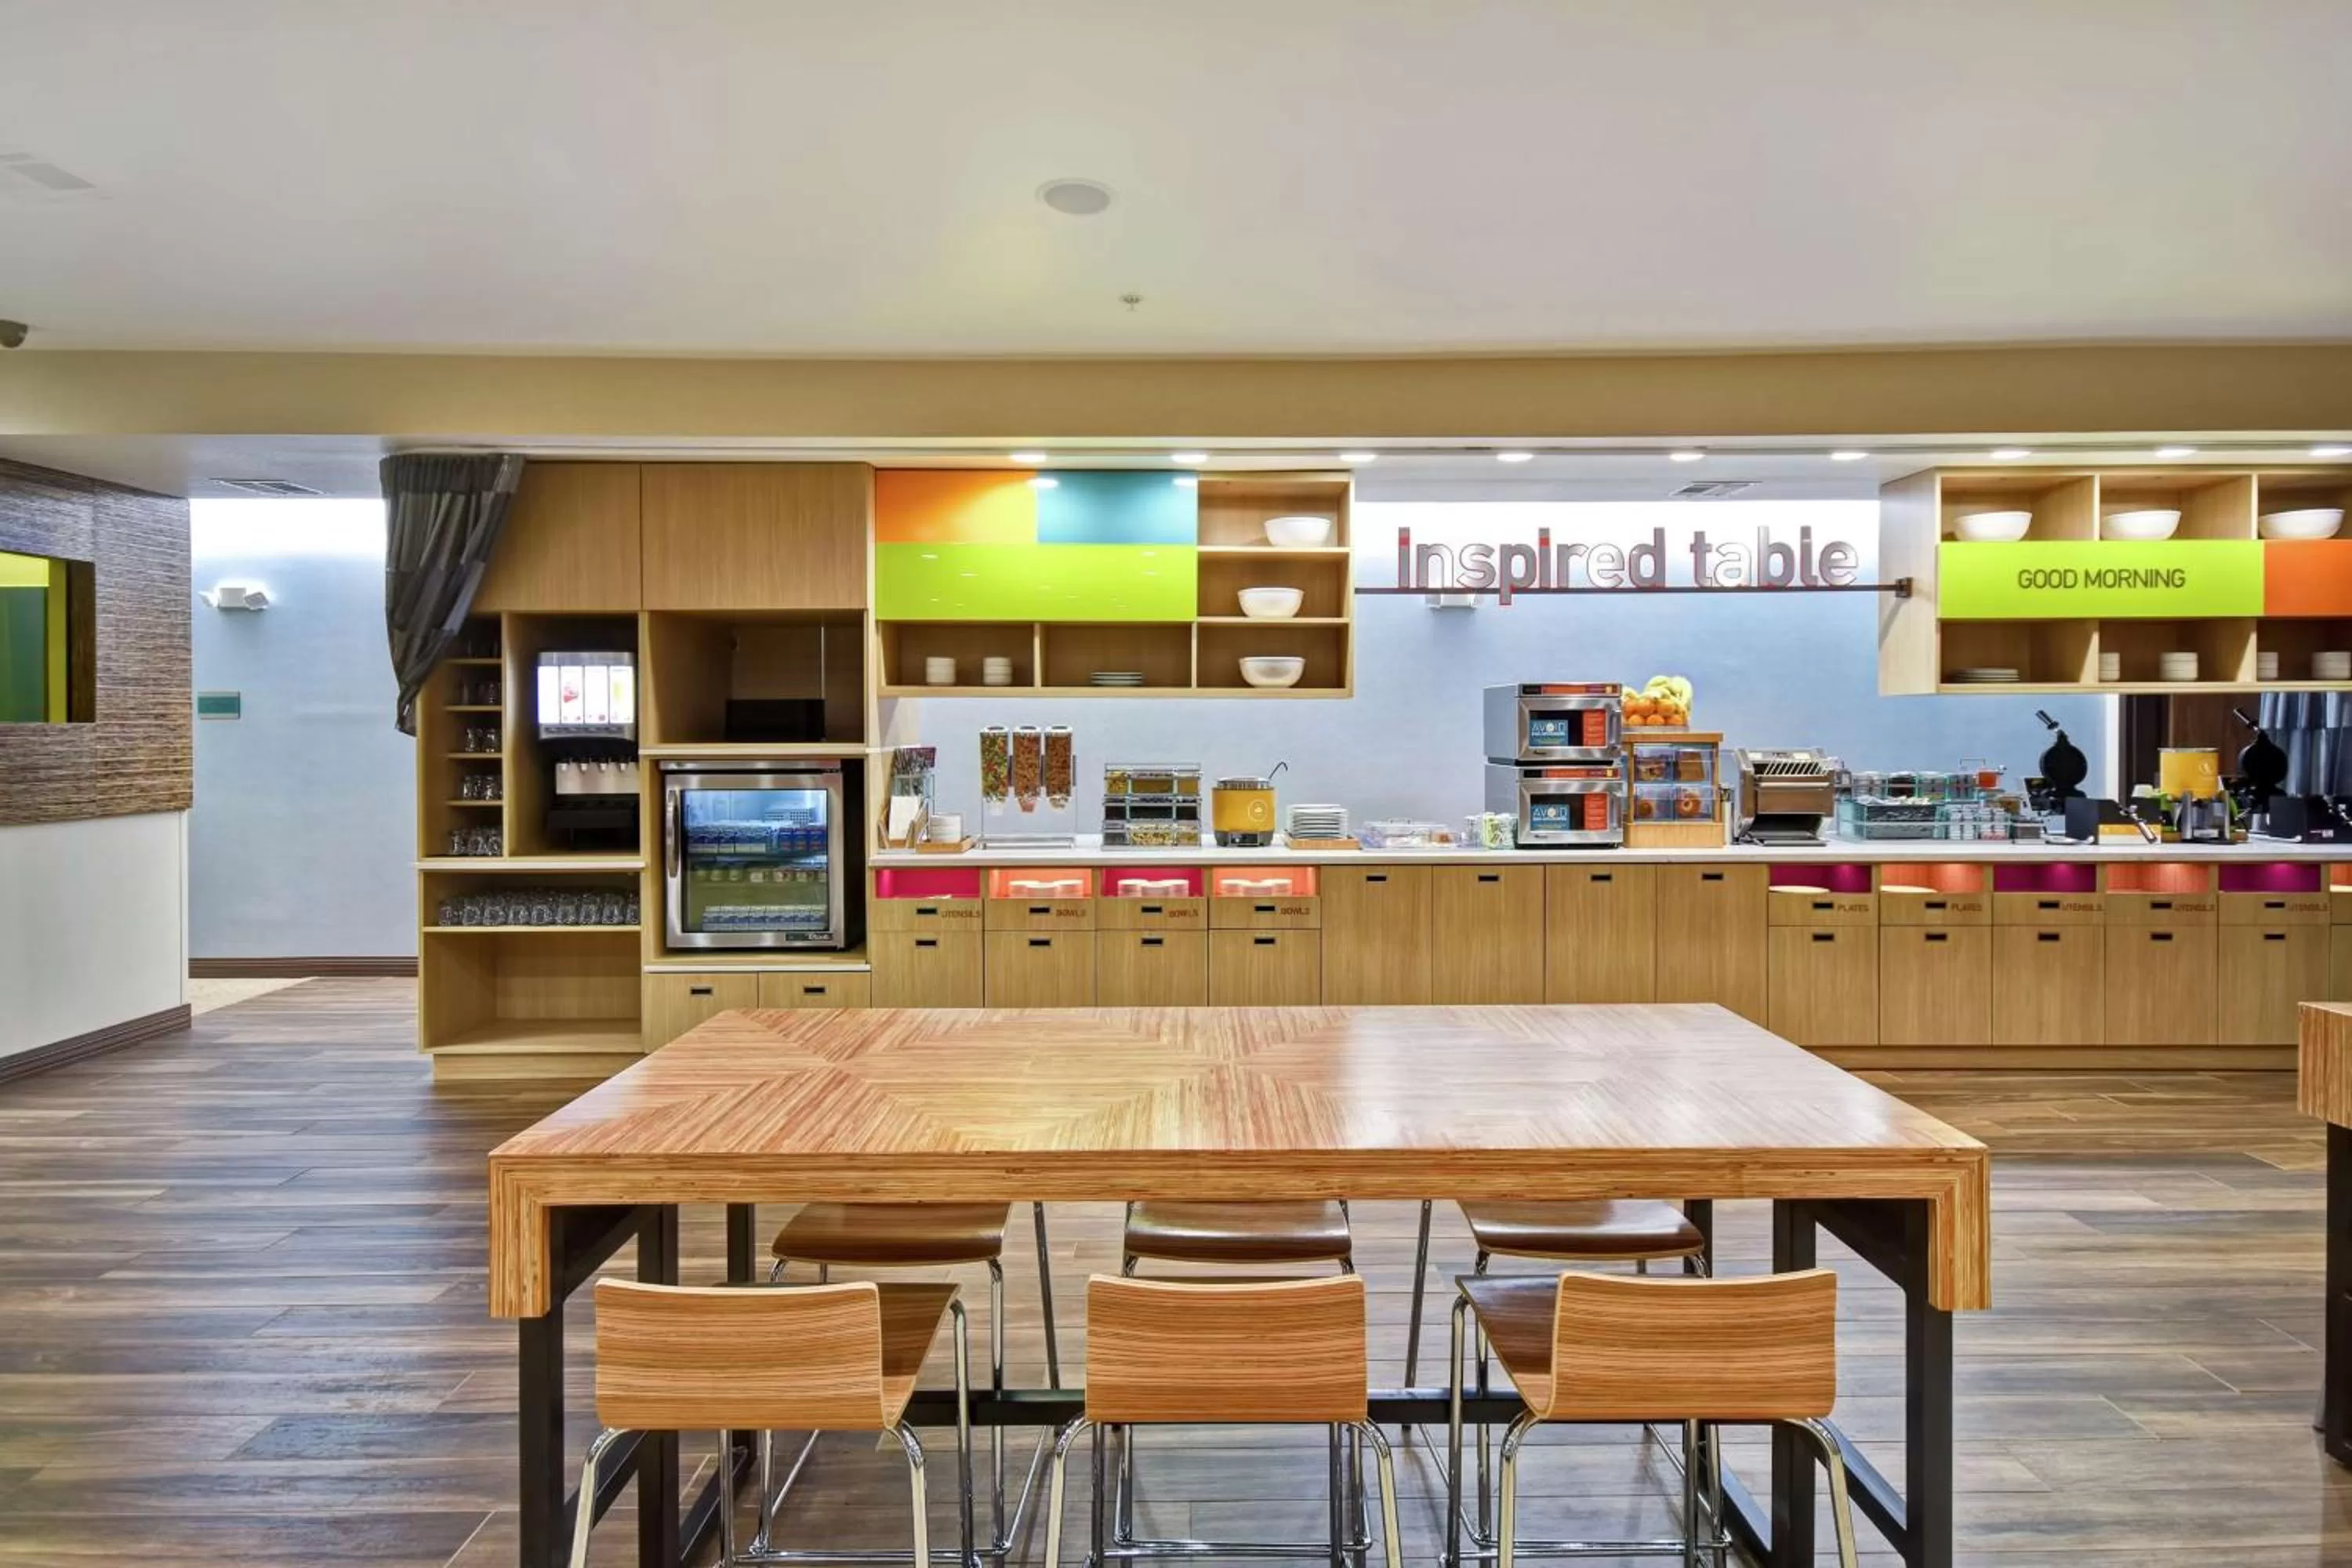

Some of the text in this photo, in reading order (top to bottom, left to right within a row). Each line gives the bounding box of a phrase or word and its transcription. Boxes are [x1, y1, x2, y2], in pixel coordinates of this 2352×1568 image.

[1398, 525, 1859, 605] inspired table
[2018, 568, 2186, 589] GOOD MORNING
[1056, 908, 1087, 916] BOWLS
[1168, 908, 1199, 917] BOWLS
[1280, 907, 1310, 916] BOWLS
[1837, 903, 1870, 913] PLATES
[941, 909, 981, 918] UTENSILS
